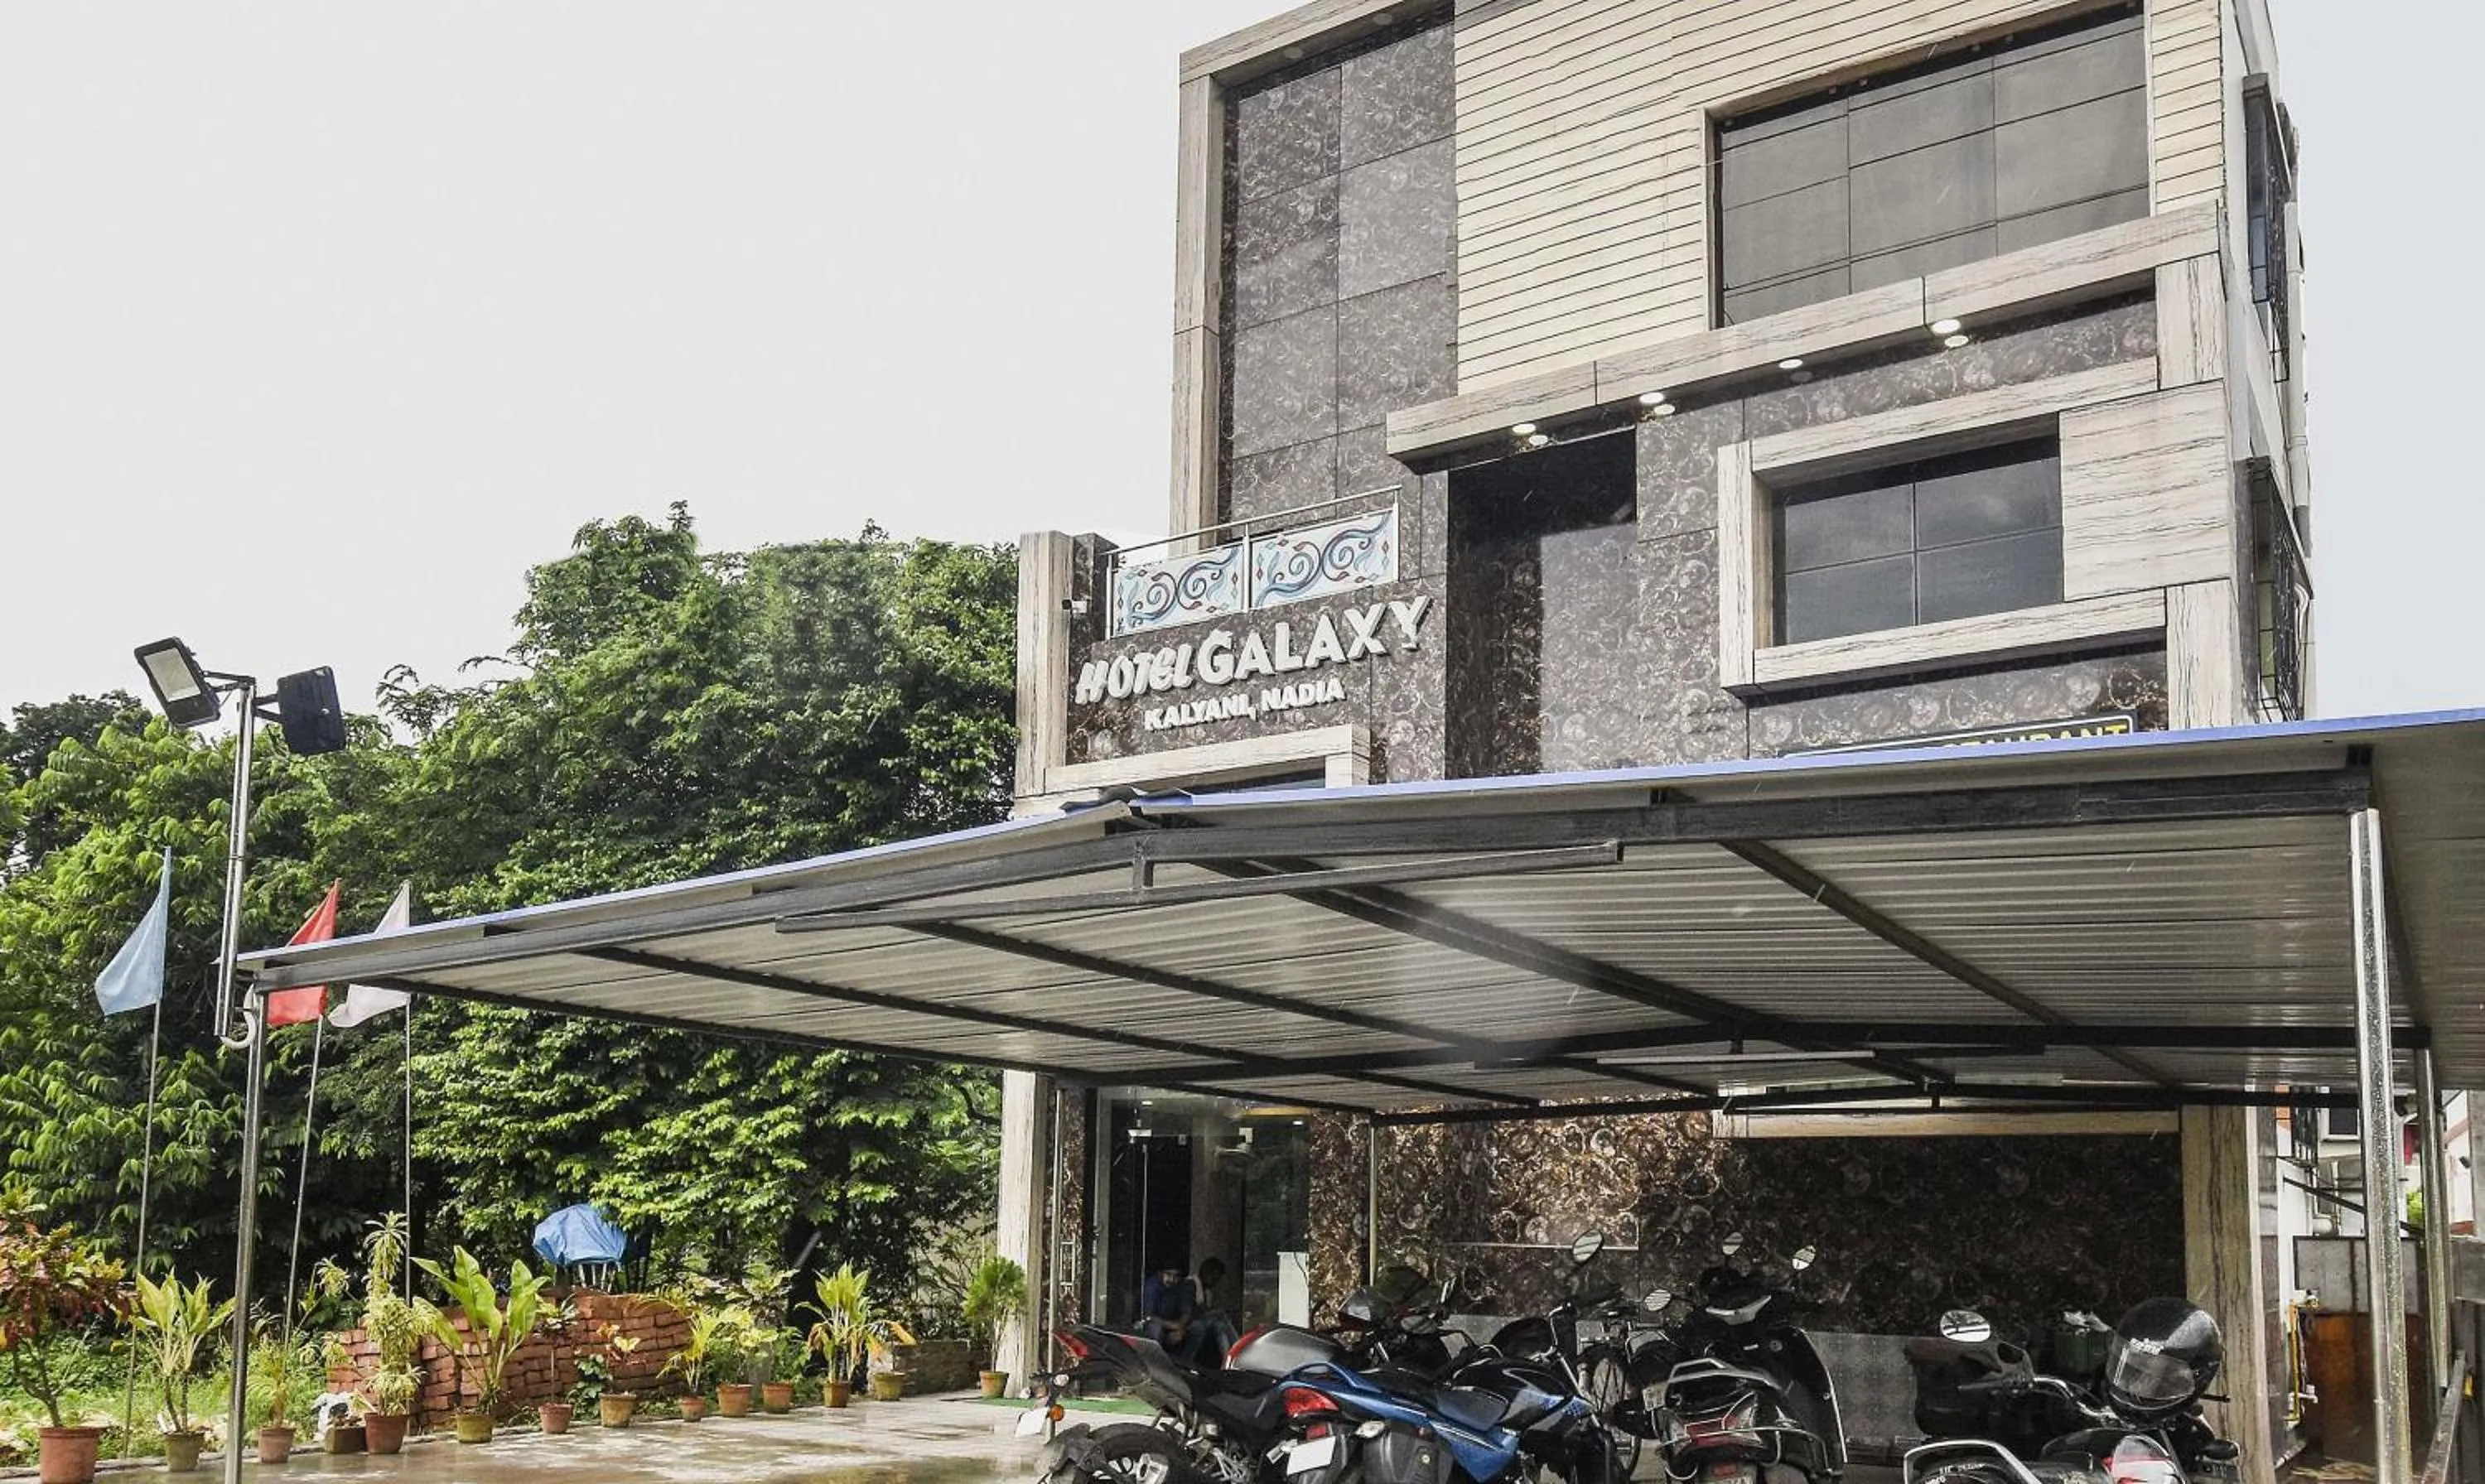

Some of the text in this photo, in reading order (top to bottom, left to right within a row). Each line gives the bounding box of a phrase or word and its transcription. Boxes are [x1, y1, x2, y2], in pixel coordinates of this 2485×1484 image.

[1198, 595, 1430, 685] GALAXY
[1145, 677, 1346, 730] KALYANI, NADIA
